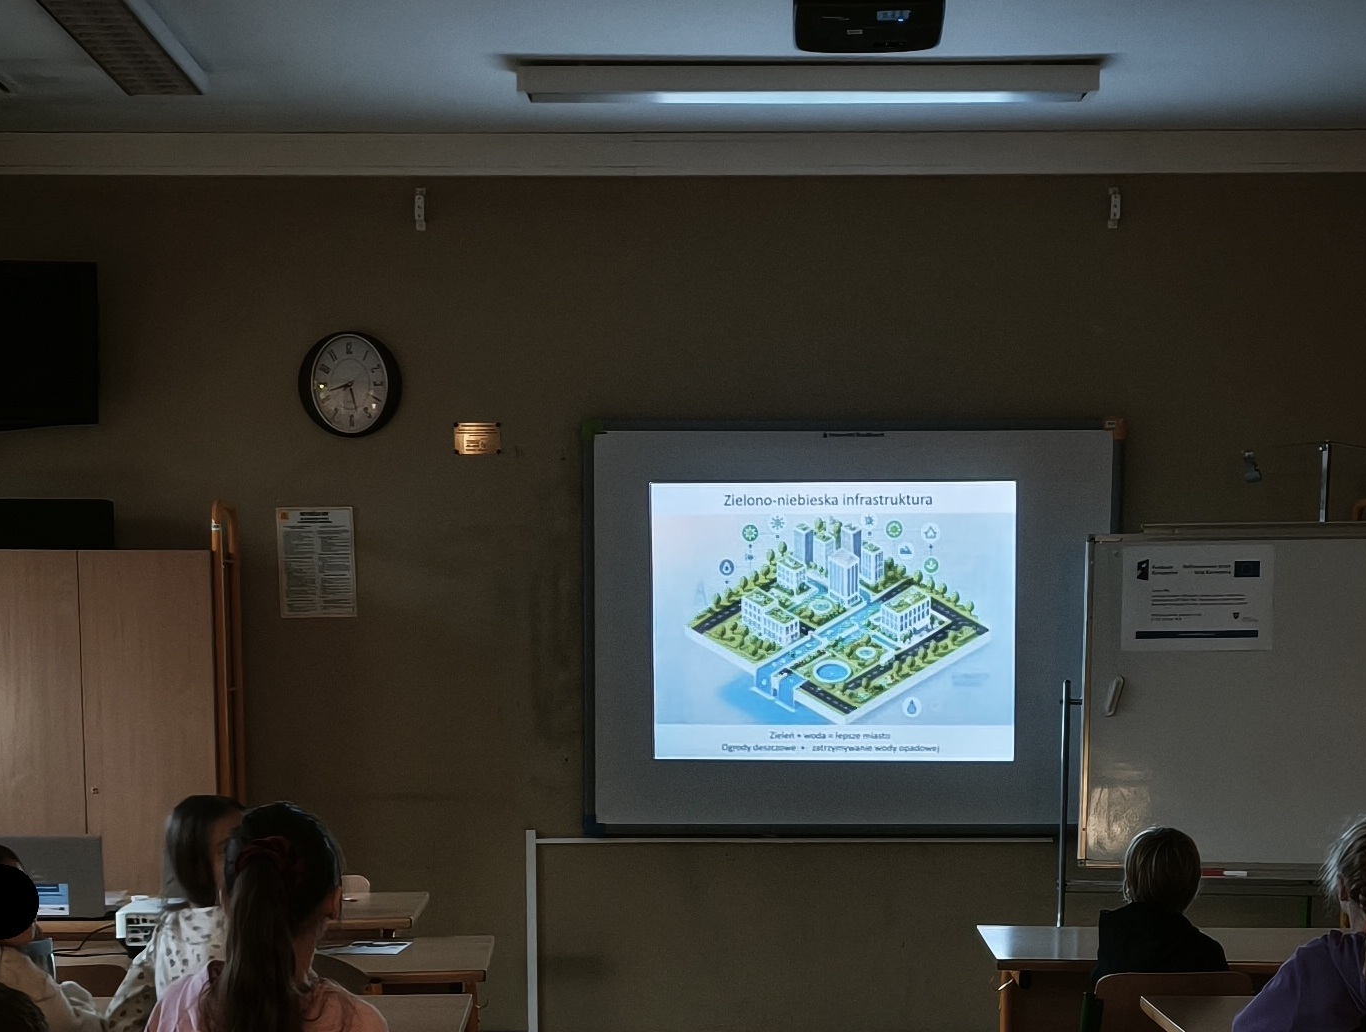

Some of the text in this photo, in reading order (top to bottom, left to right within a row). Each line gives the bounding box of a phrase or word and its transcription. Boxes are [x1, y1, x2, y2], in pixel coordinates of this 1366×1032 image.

[723, 493, 933, 507] Zielono-niebieska infrastruktura
[803, 732, 827, 740] woda
[862, 732, 891, 740] miasto
